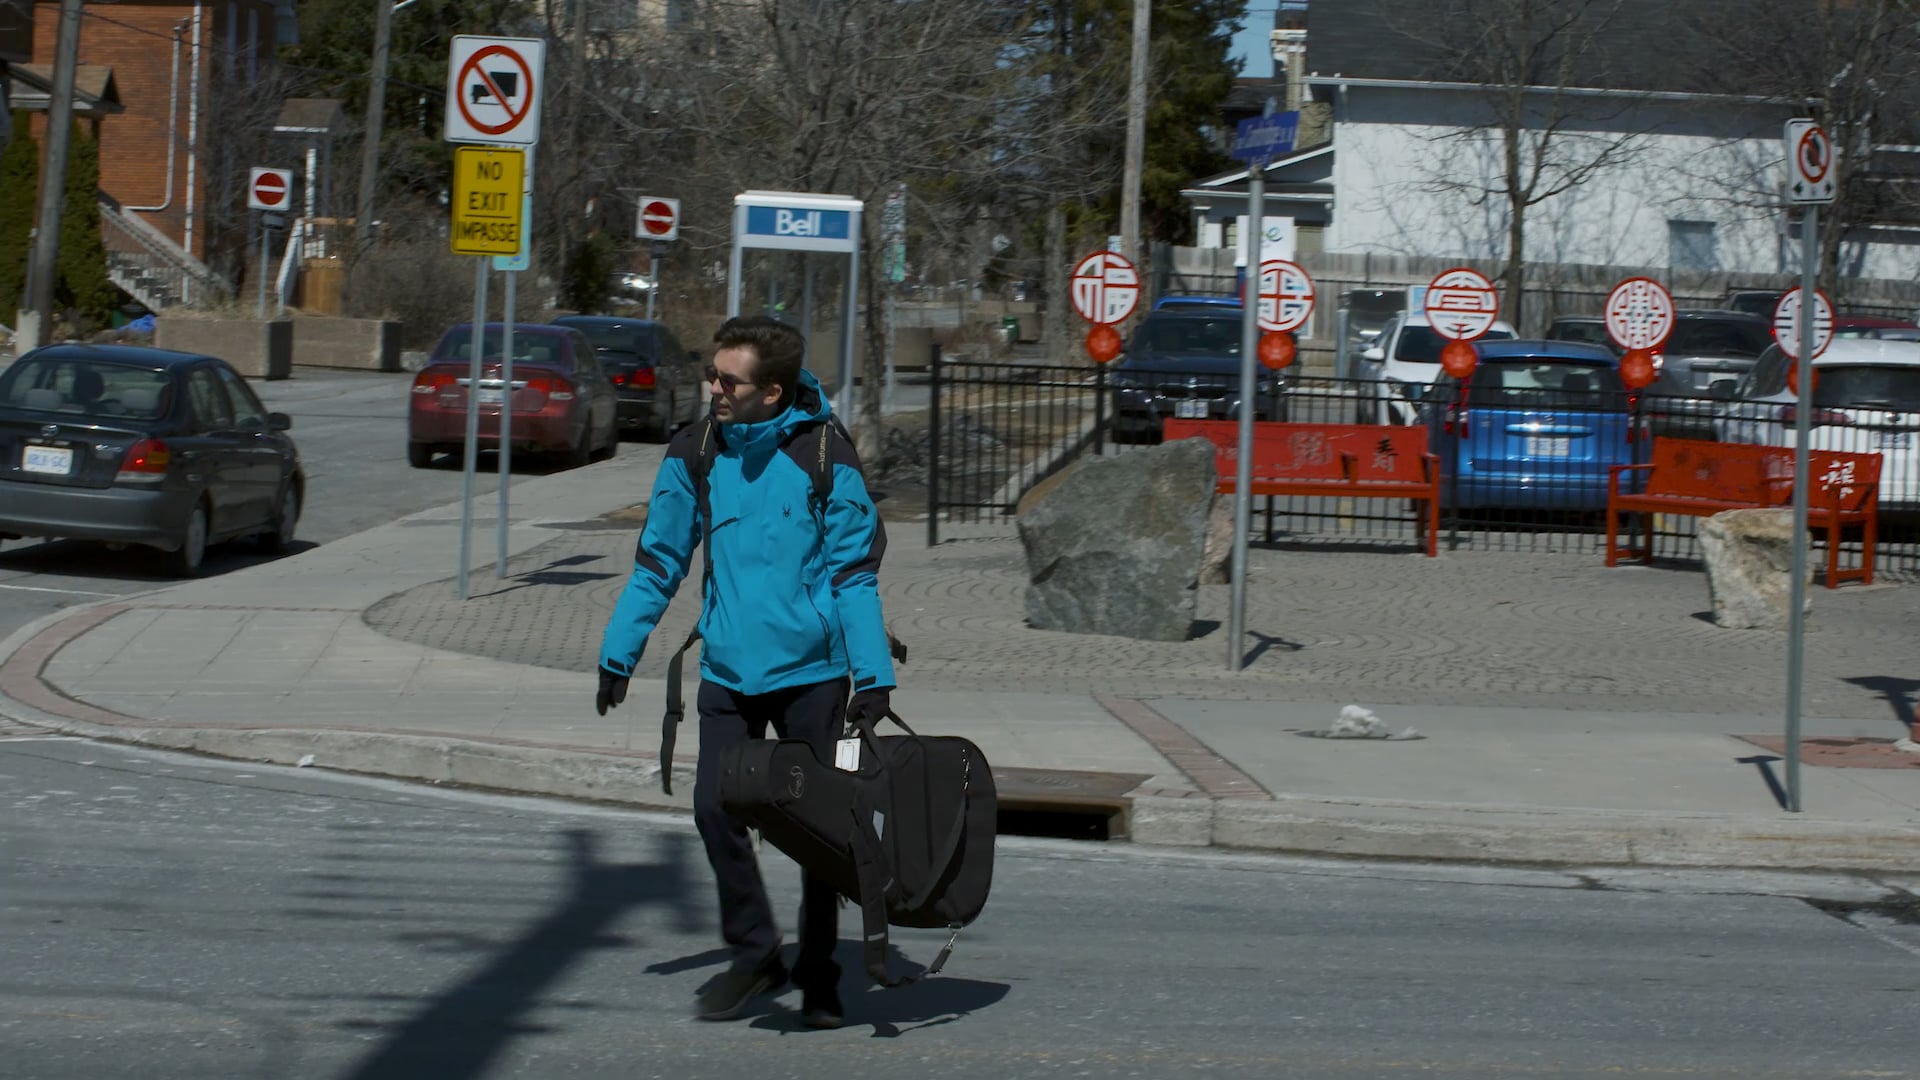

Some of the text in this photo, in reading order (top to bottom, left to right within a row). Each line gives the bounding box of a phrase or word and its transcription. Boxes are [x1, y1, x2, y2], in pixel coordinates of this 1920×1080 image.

[477, 161, 503, 180] NO
[469, 191, 508, 211] EXIT
[456, 221, 517, 242] IMPASSE
[776, 209, 821, 236] Bell
